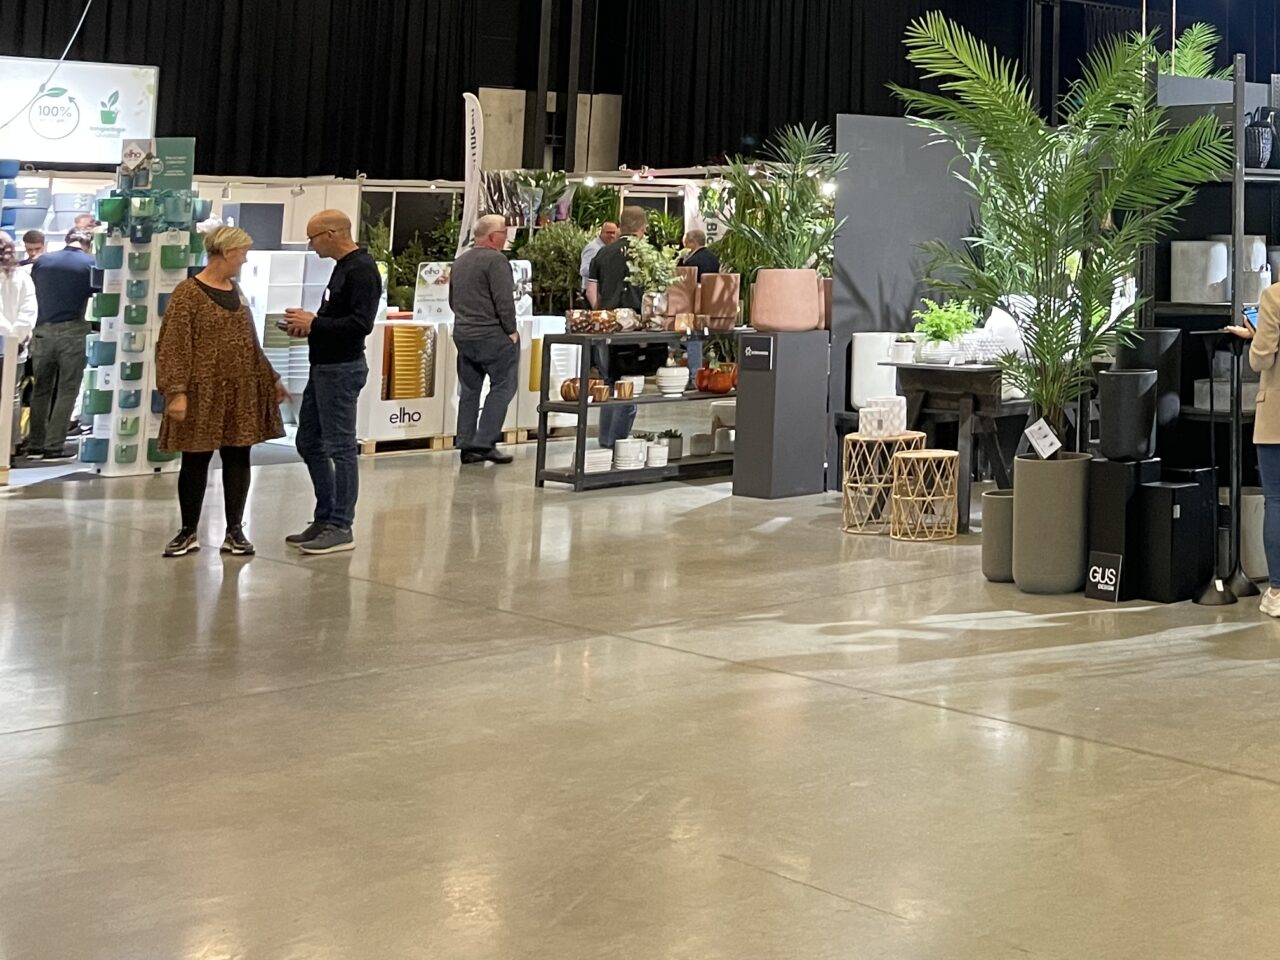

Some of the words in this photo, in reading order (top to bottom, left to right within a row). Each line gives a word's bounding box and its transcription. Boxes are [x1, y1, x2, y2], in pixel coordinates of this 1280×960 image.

[39, 105, 72, 117] 100%
[389, 406, 422, 424] elho
[1089, 565, 1116, 585] GUS
